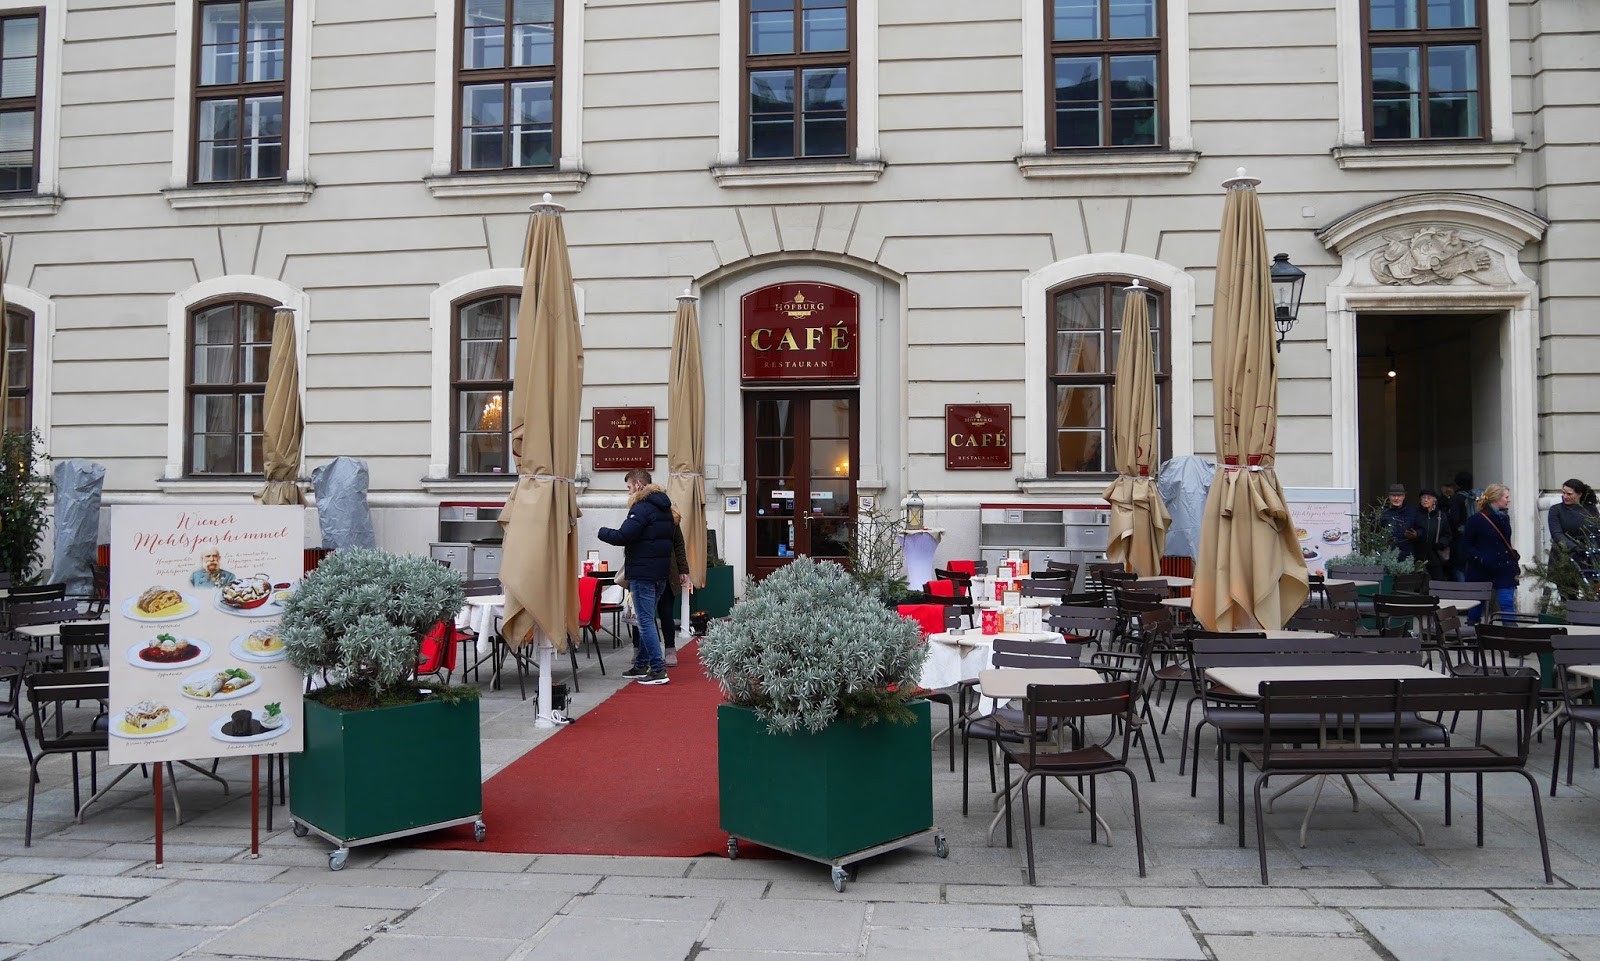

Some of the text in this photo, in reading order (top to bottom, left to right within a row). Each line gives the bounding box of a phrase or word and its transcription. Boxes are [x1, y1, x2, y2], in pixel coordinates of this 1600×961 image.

[775, 303, 825, 311] HOFBURG
[750, 320, 850, 351] CAFÉ
[597, 431, 650, 449] CAFÉ
[950, 430, 1007, 447] CAFÉ
[176, 511, 237, 530] Wiener
[133, 526, 289, 554] Mehlspeishimmel
